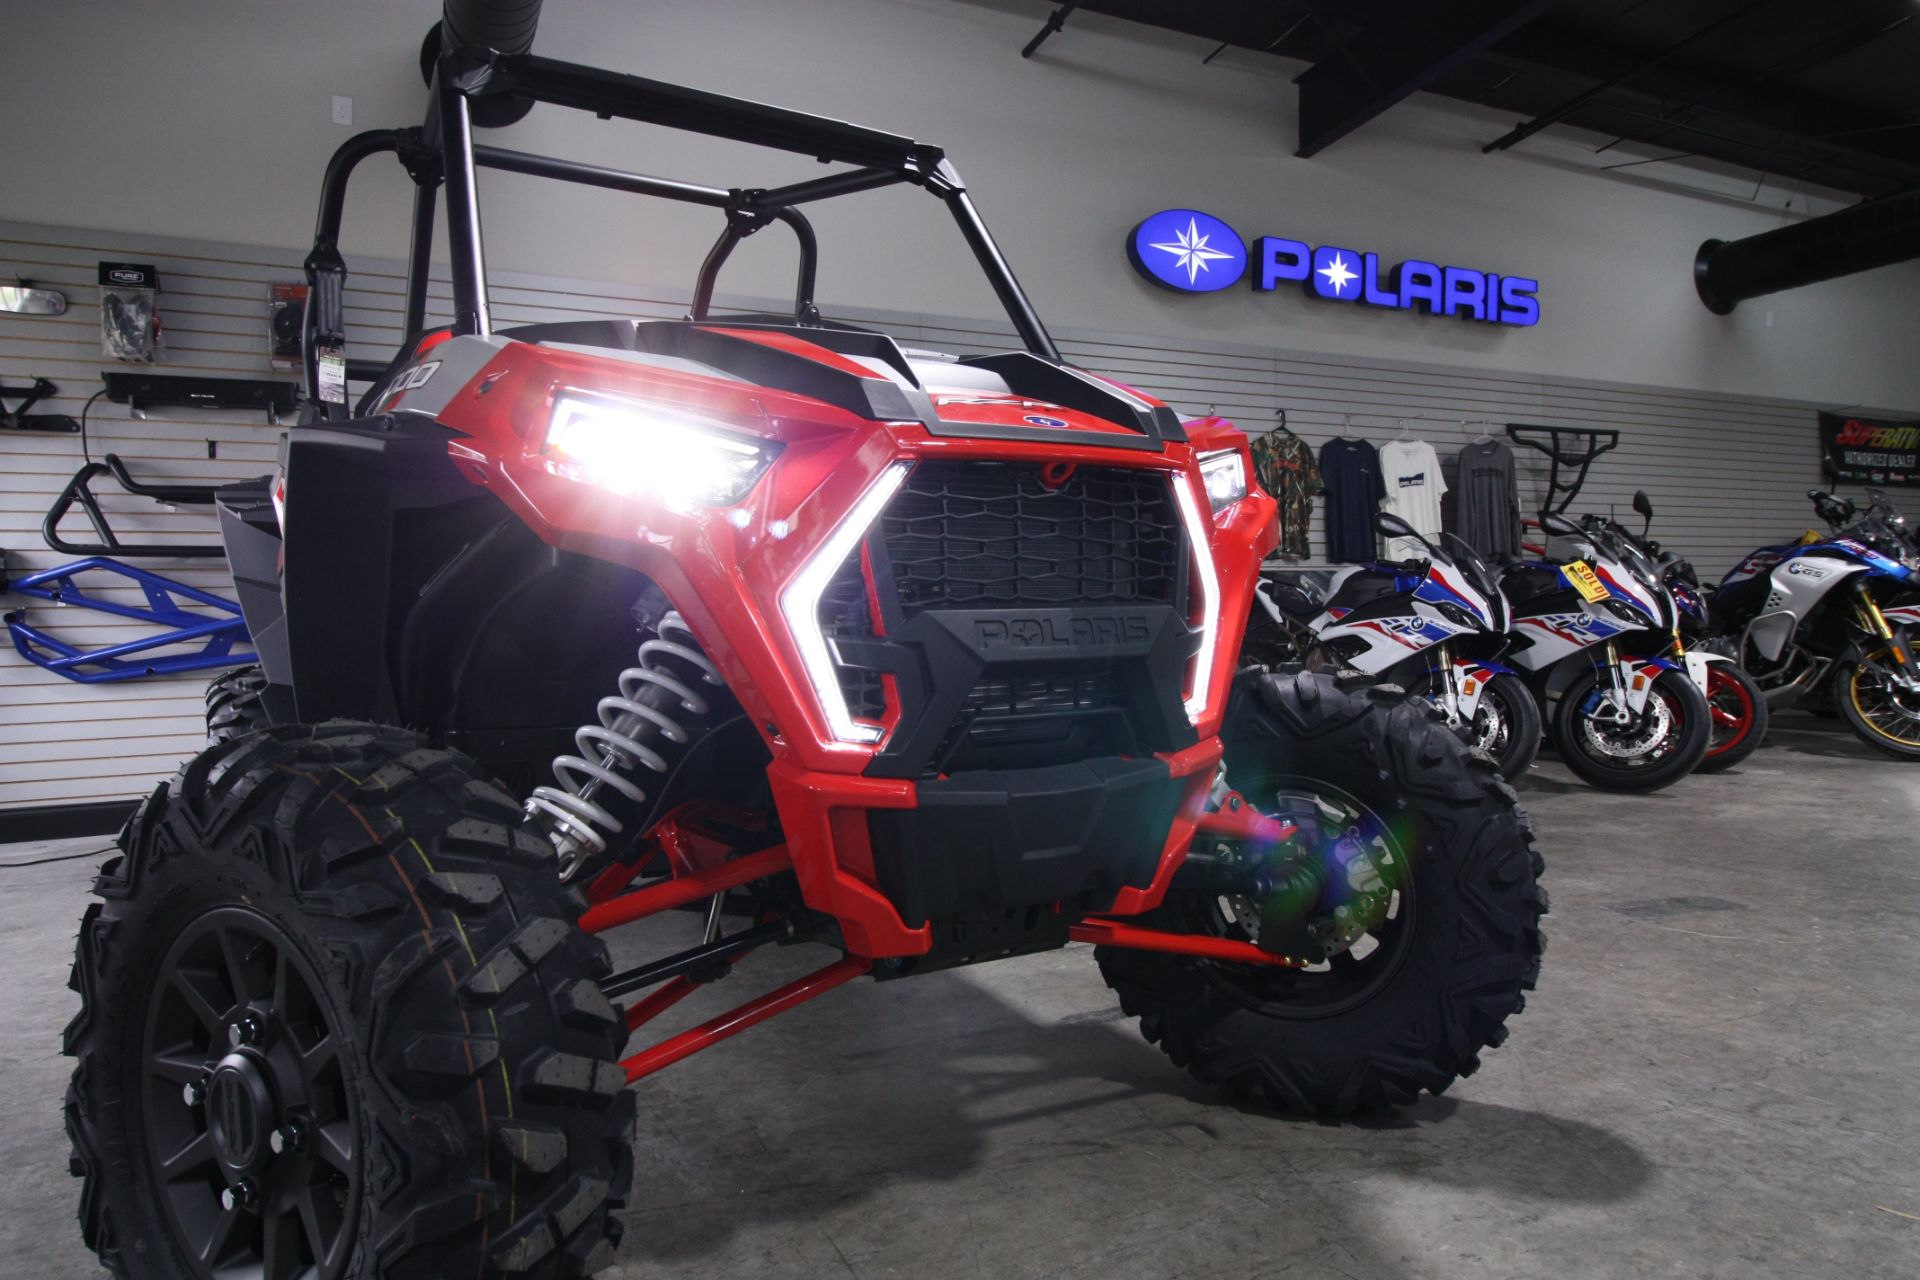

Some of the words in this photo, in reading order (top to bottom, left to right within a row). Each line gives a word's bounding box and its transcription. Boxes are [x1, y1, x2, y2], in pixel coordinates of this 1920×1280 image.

[1254, 236, 1540, 327] POLARIS
[1844, 451, 1887, 467] AUTHORIZED
[1888, 454, 1916, 468] DEALER
[1577, 565, 1606, 594] SOLD
[1802, 568, 1823, 578] GS
[974, 616, 1149, 649] POLARIS
